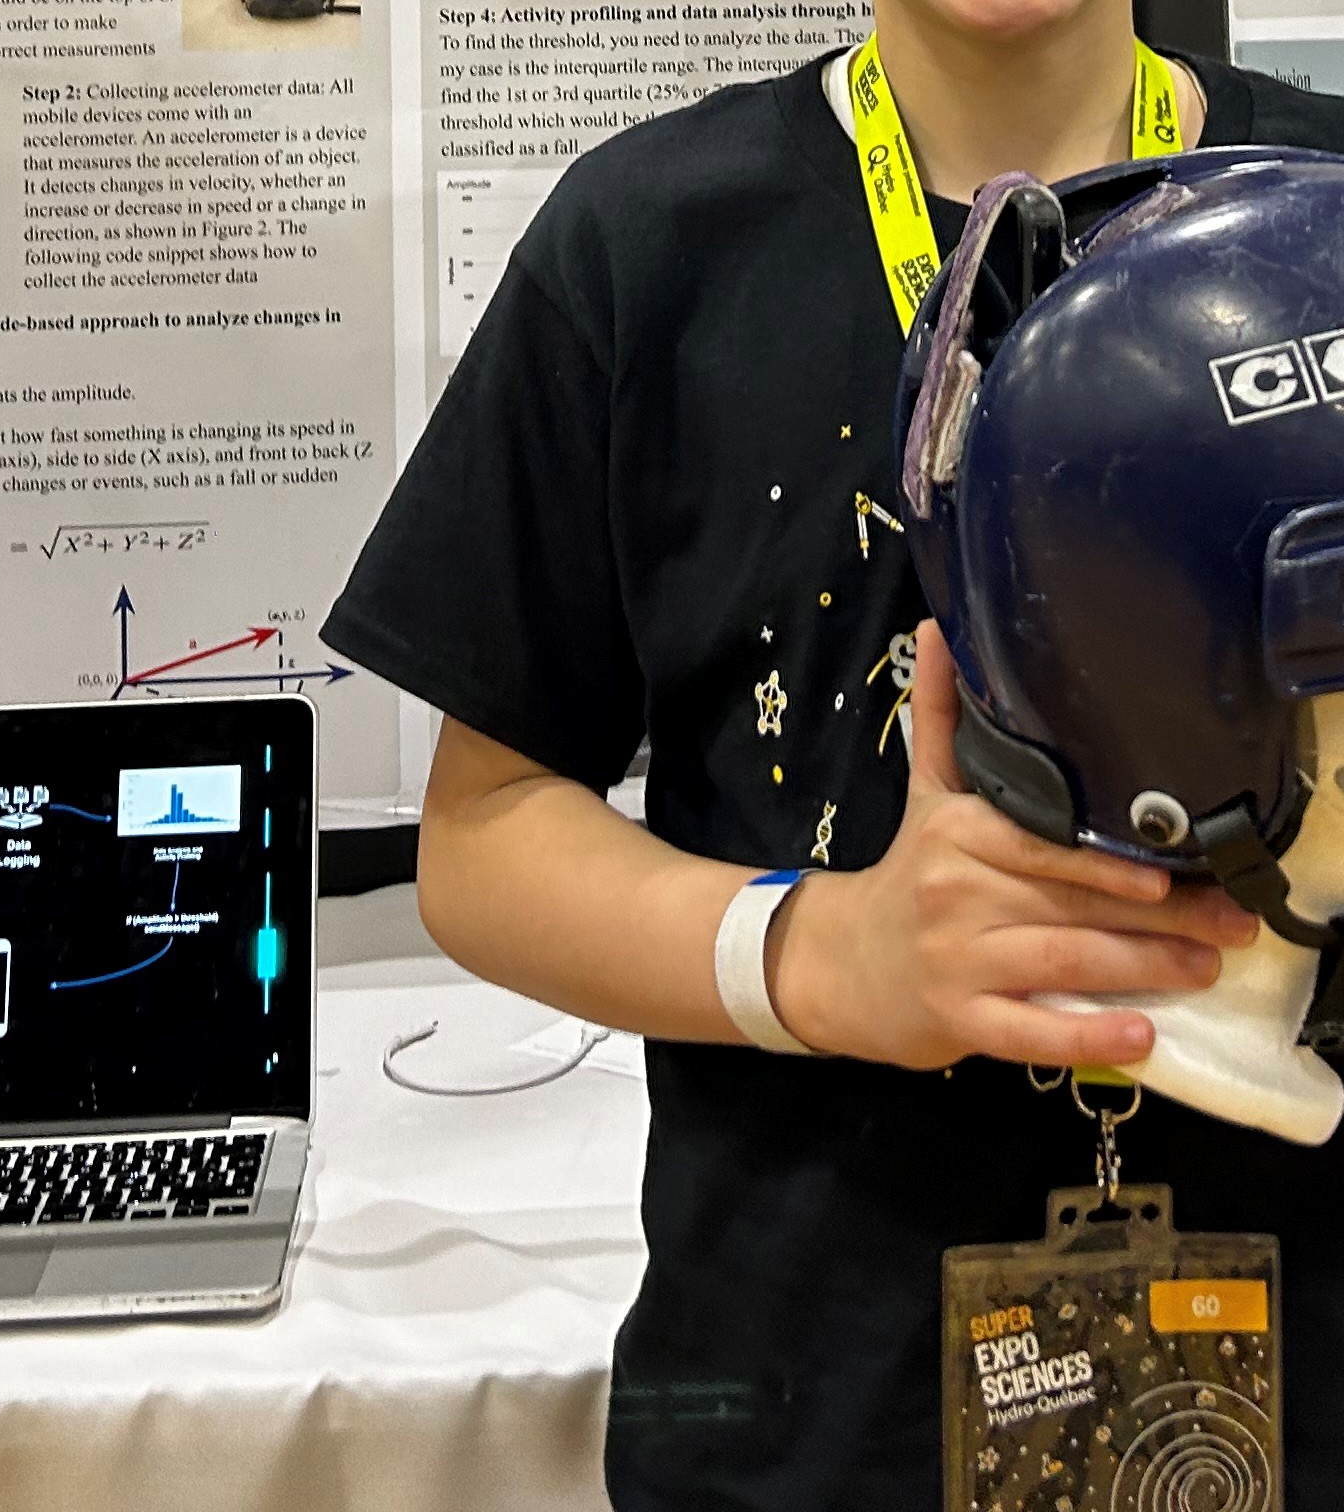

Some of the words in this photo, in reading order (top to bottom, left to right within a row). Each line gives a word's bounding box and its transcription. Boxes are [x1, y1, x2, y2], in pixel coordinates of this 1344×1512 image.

[440, 9, 476, 27] Step
[481, 8, 496, 24] 4:
[501, 6, 566, 26] Activity
[570, 5, 642, 26] profiling
[647, 4, 677, 21] and
[681, 4, 718, 20] data
[722, 3, 787, 22] analysis
[792, 2, 856, 21] through
[440, 35, 460, 50] To
[465, 33, 496, 50] find
[501, 33, 525, 50] the
[529, 32, 606, 49] threshold,
[610, 36, 639, 52] you
[644, 31, 680, 47] need
[684, 33, 700, 47] to
[704, 29, 762, 49] analyze
[767, 29, 790, 45] the
[834, 28, 865, 44] The
[23, 85, 61, 104] Step
[66, 84, 81, 101] 2:
[86, 83, 170, 102] Collecting
[173, 81, 283, 98] accelerometer
[287, 80, 325, 96] data:
[329, 78, 354, 95] All
[80, 311, 159, 333] approach
[166, 313, 182, 328] to
[186, 310, 249, 330] analyze
[253, 308, 321, 328] changes
[326, 307, 342, 324] in
[22, 386, 47, 402] the
[1191, 1295, 1221, 1318] 60
[970, 1305, 1034, 1342] SUPER
[973, 1331, 1040, 1376] EXPO
[980, 1350, 1094, 1406] SCIENCES
